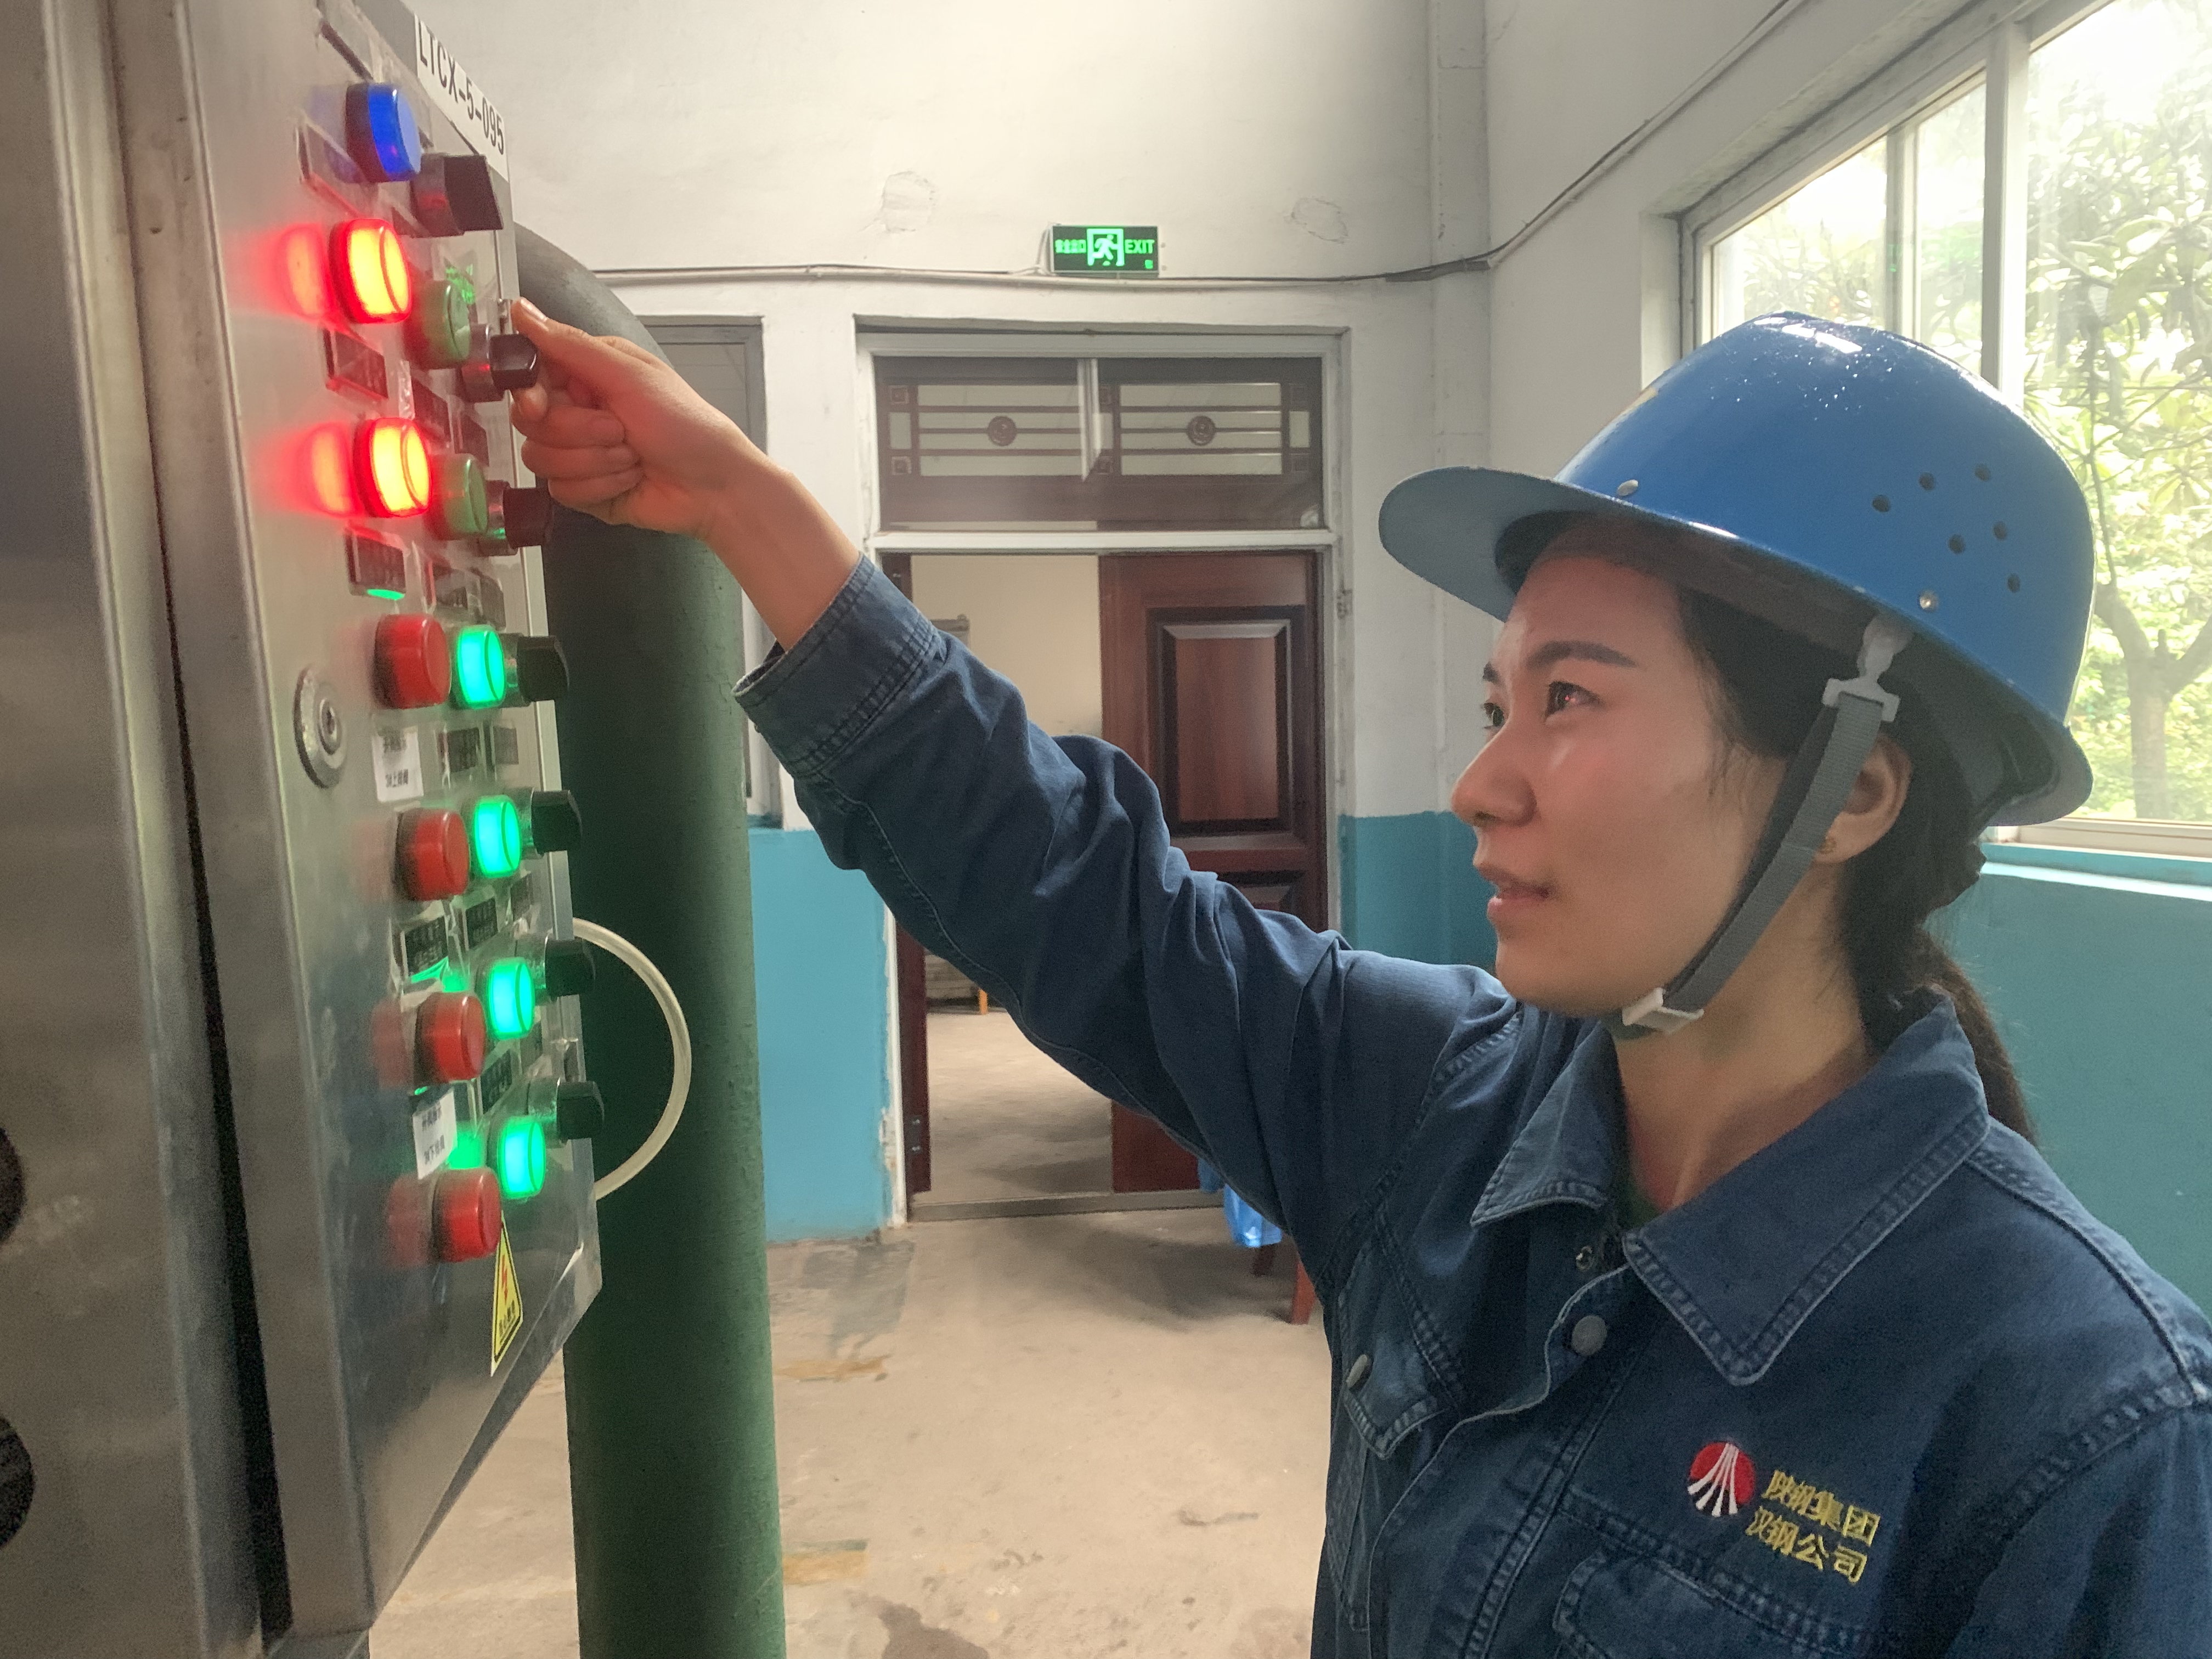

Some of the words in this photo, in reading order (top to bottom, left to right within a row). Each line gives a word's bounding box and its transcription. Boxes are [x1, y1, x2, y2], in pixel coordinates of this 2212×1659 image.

[418, 21, 504, 155] LTCX-5-095
[1125, 239, 1155, 254] EXIT
[1745, 1506, 1868, 1584] 汉钢公司
[1761, 1469, 1881, 1547] 陕钢集团
